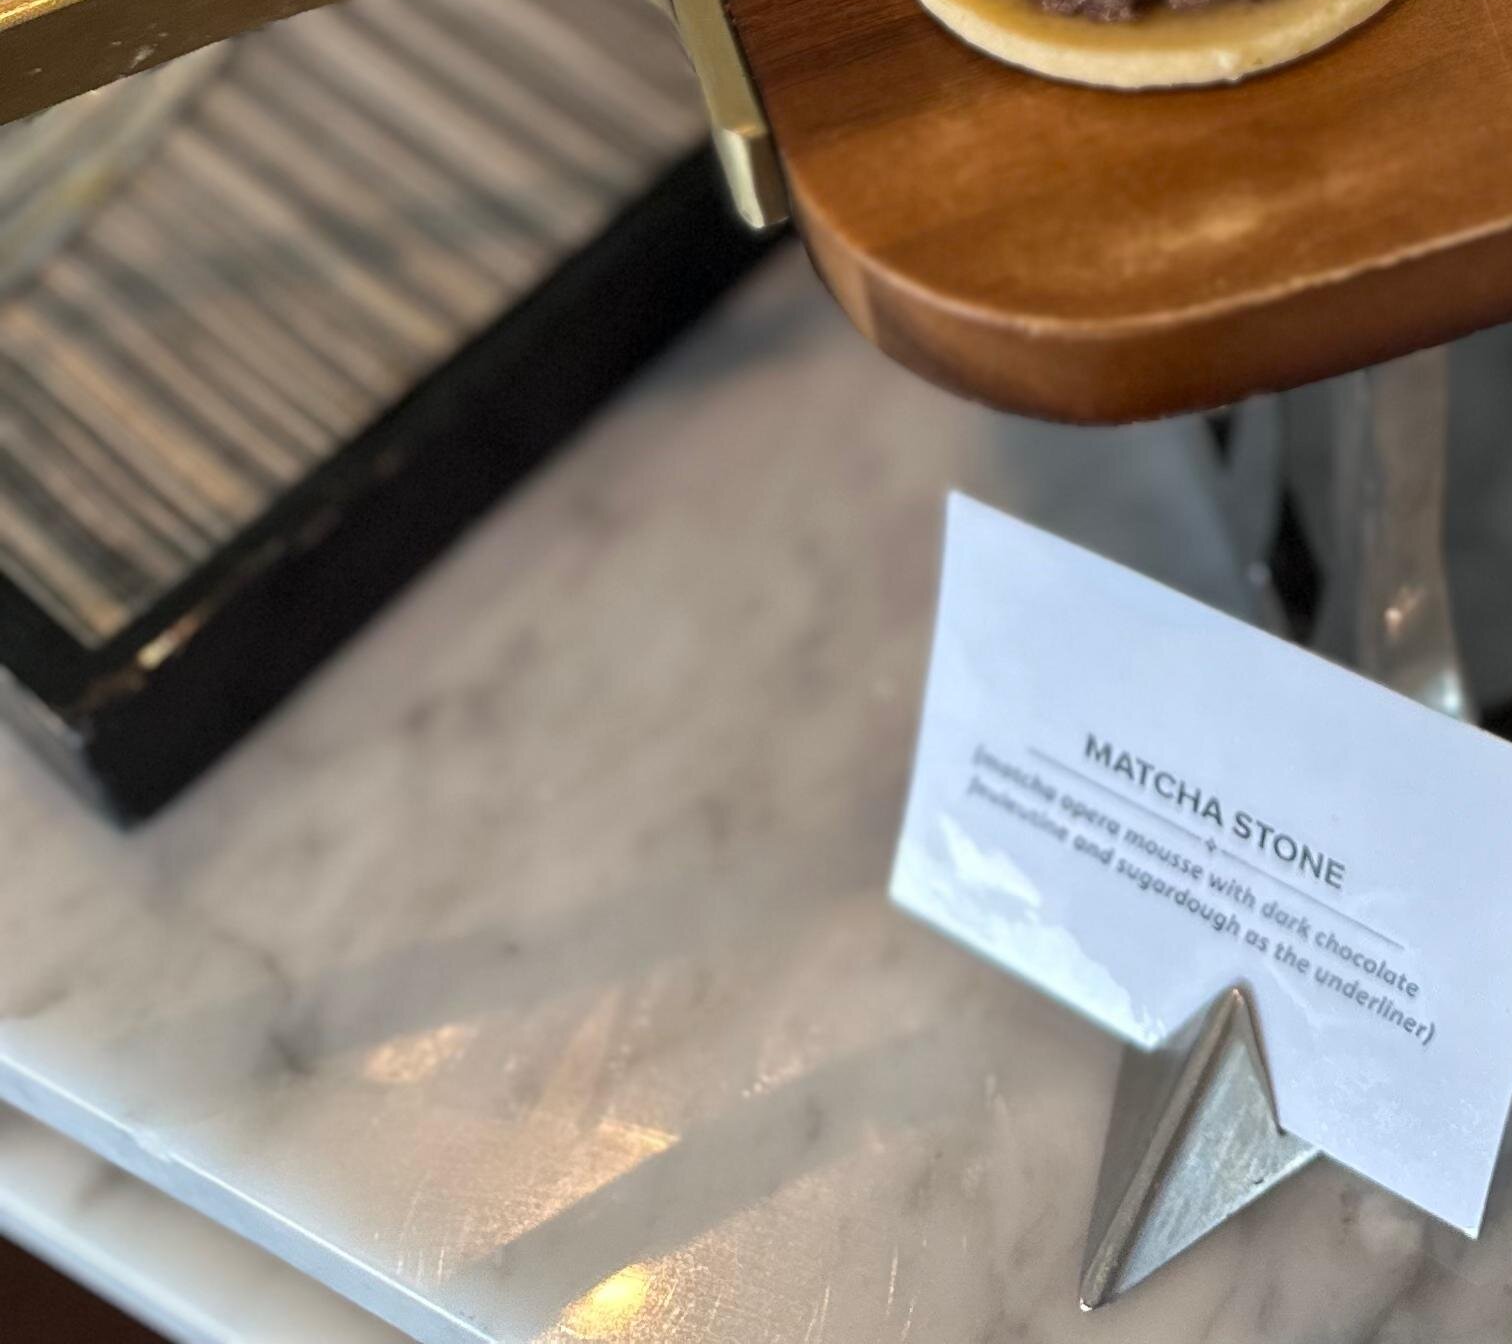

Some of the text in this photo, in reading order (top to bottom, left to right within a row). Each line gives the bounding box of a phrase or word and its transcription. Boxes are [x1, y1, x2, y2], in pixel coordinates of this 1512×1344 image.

[1060, 796, 1119, 836] opera
[1124, 828, 1206, 878] mousse
[1208, 870, 1257, 912] with
[1261, 899, 1311, 940] dark
[1314, 926, 1420, 999] chocolate
[1084, 732, 1346, 890] MATCHA STONE
[1073, 834, 1113, 866] and
[1117, 856, 1241, 938] sugardough
[1244, 928, 1268, 952] as
[1273, 939, 1310, 975] the
[1313, 964, 1437, 1048] underliner)
